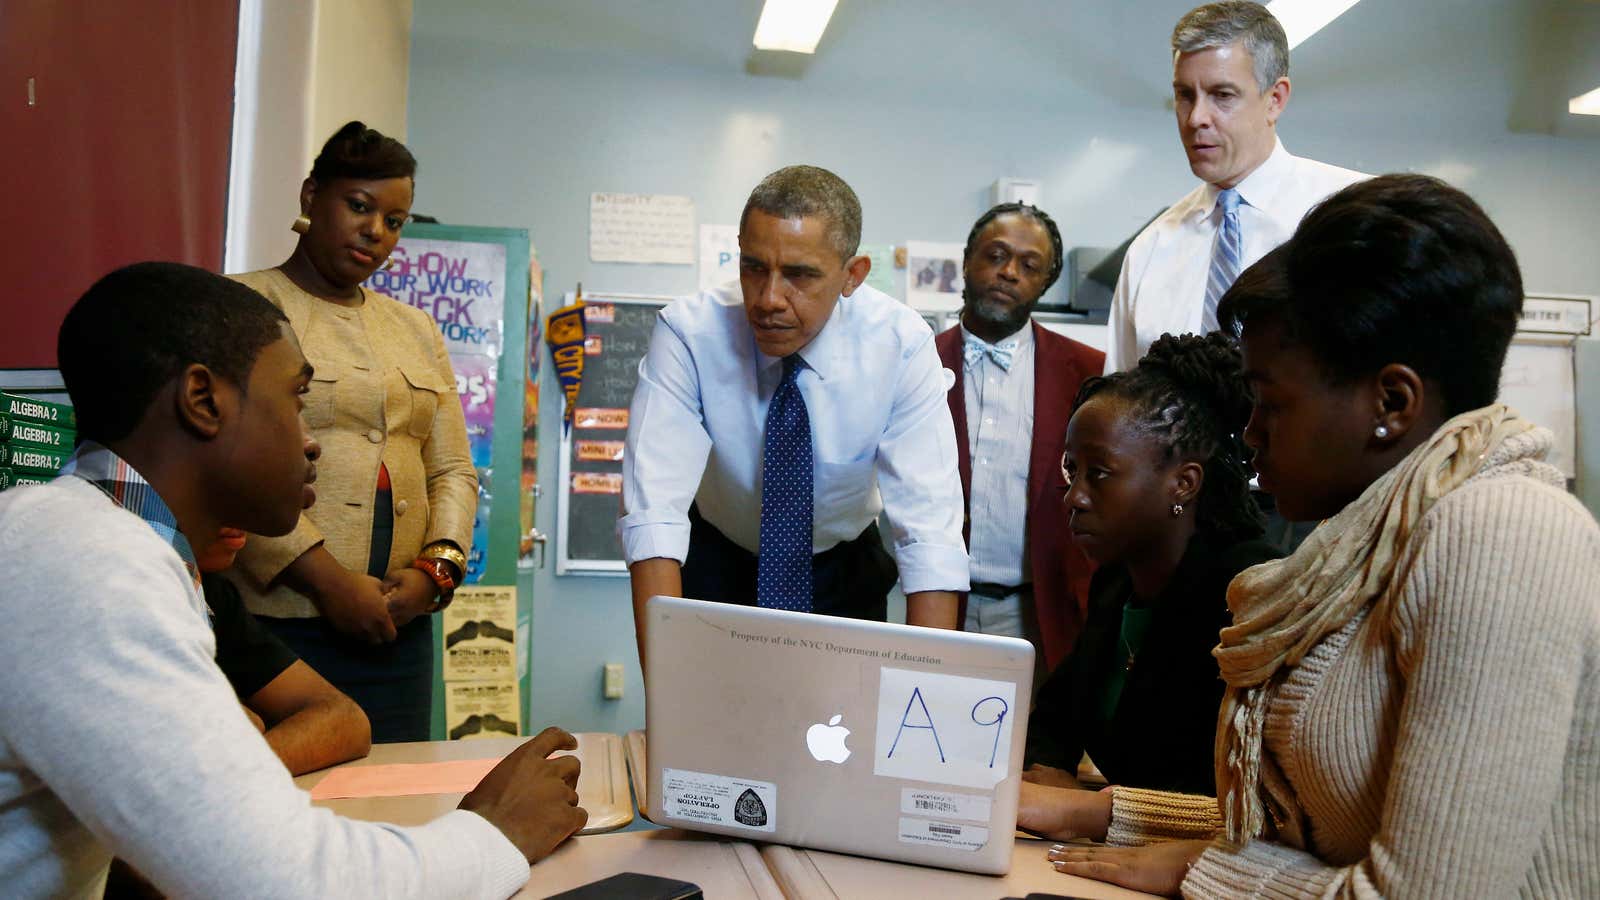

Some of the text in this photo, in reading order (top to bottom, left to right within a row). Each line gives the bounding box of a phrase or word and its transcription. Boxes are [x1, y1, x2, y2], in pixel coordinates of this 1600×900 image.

[388, 246, 467, 278] SHOW
[363, 271, 493, 298] OUR WORK
[374, 287, 474, 325] ECK
[554, 345, 584, 379] CITY
[10, 400, 58, 421] ALGEBRA 2
[12, 425, 60, 446] ALGEBRA 2
[11, 451, 53, 470] ALGEBRA
[54, 456, 61, 470] 2
[731, 630, 942, 665] Property of the NYC Department of Education
[677, 797, 720, 810] OPERATION
[683, 793, 714, 802] LAPTOP
